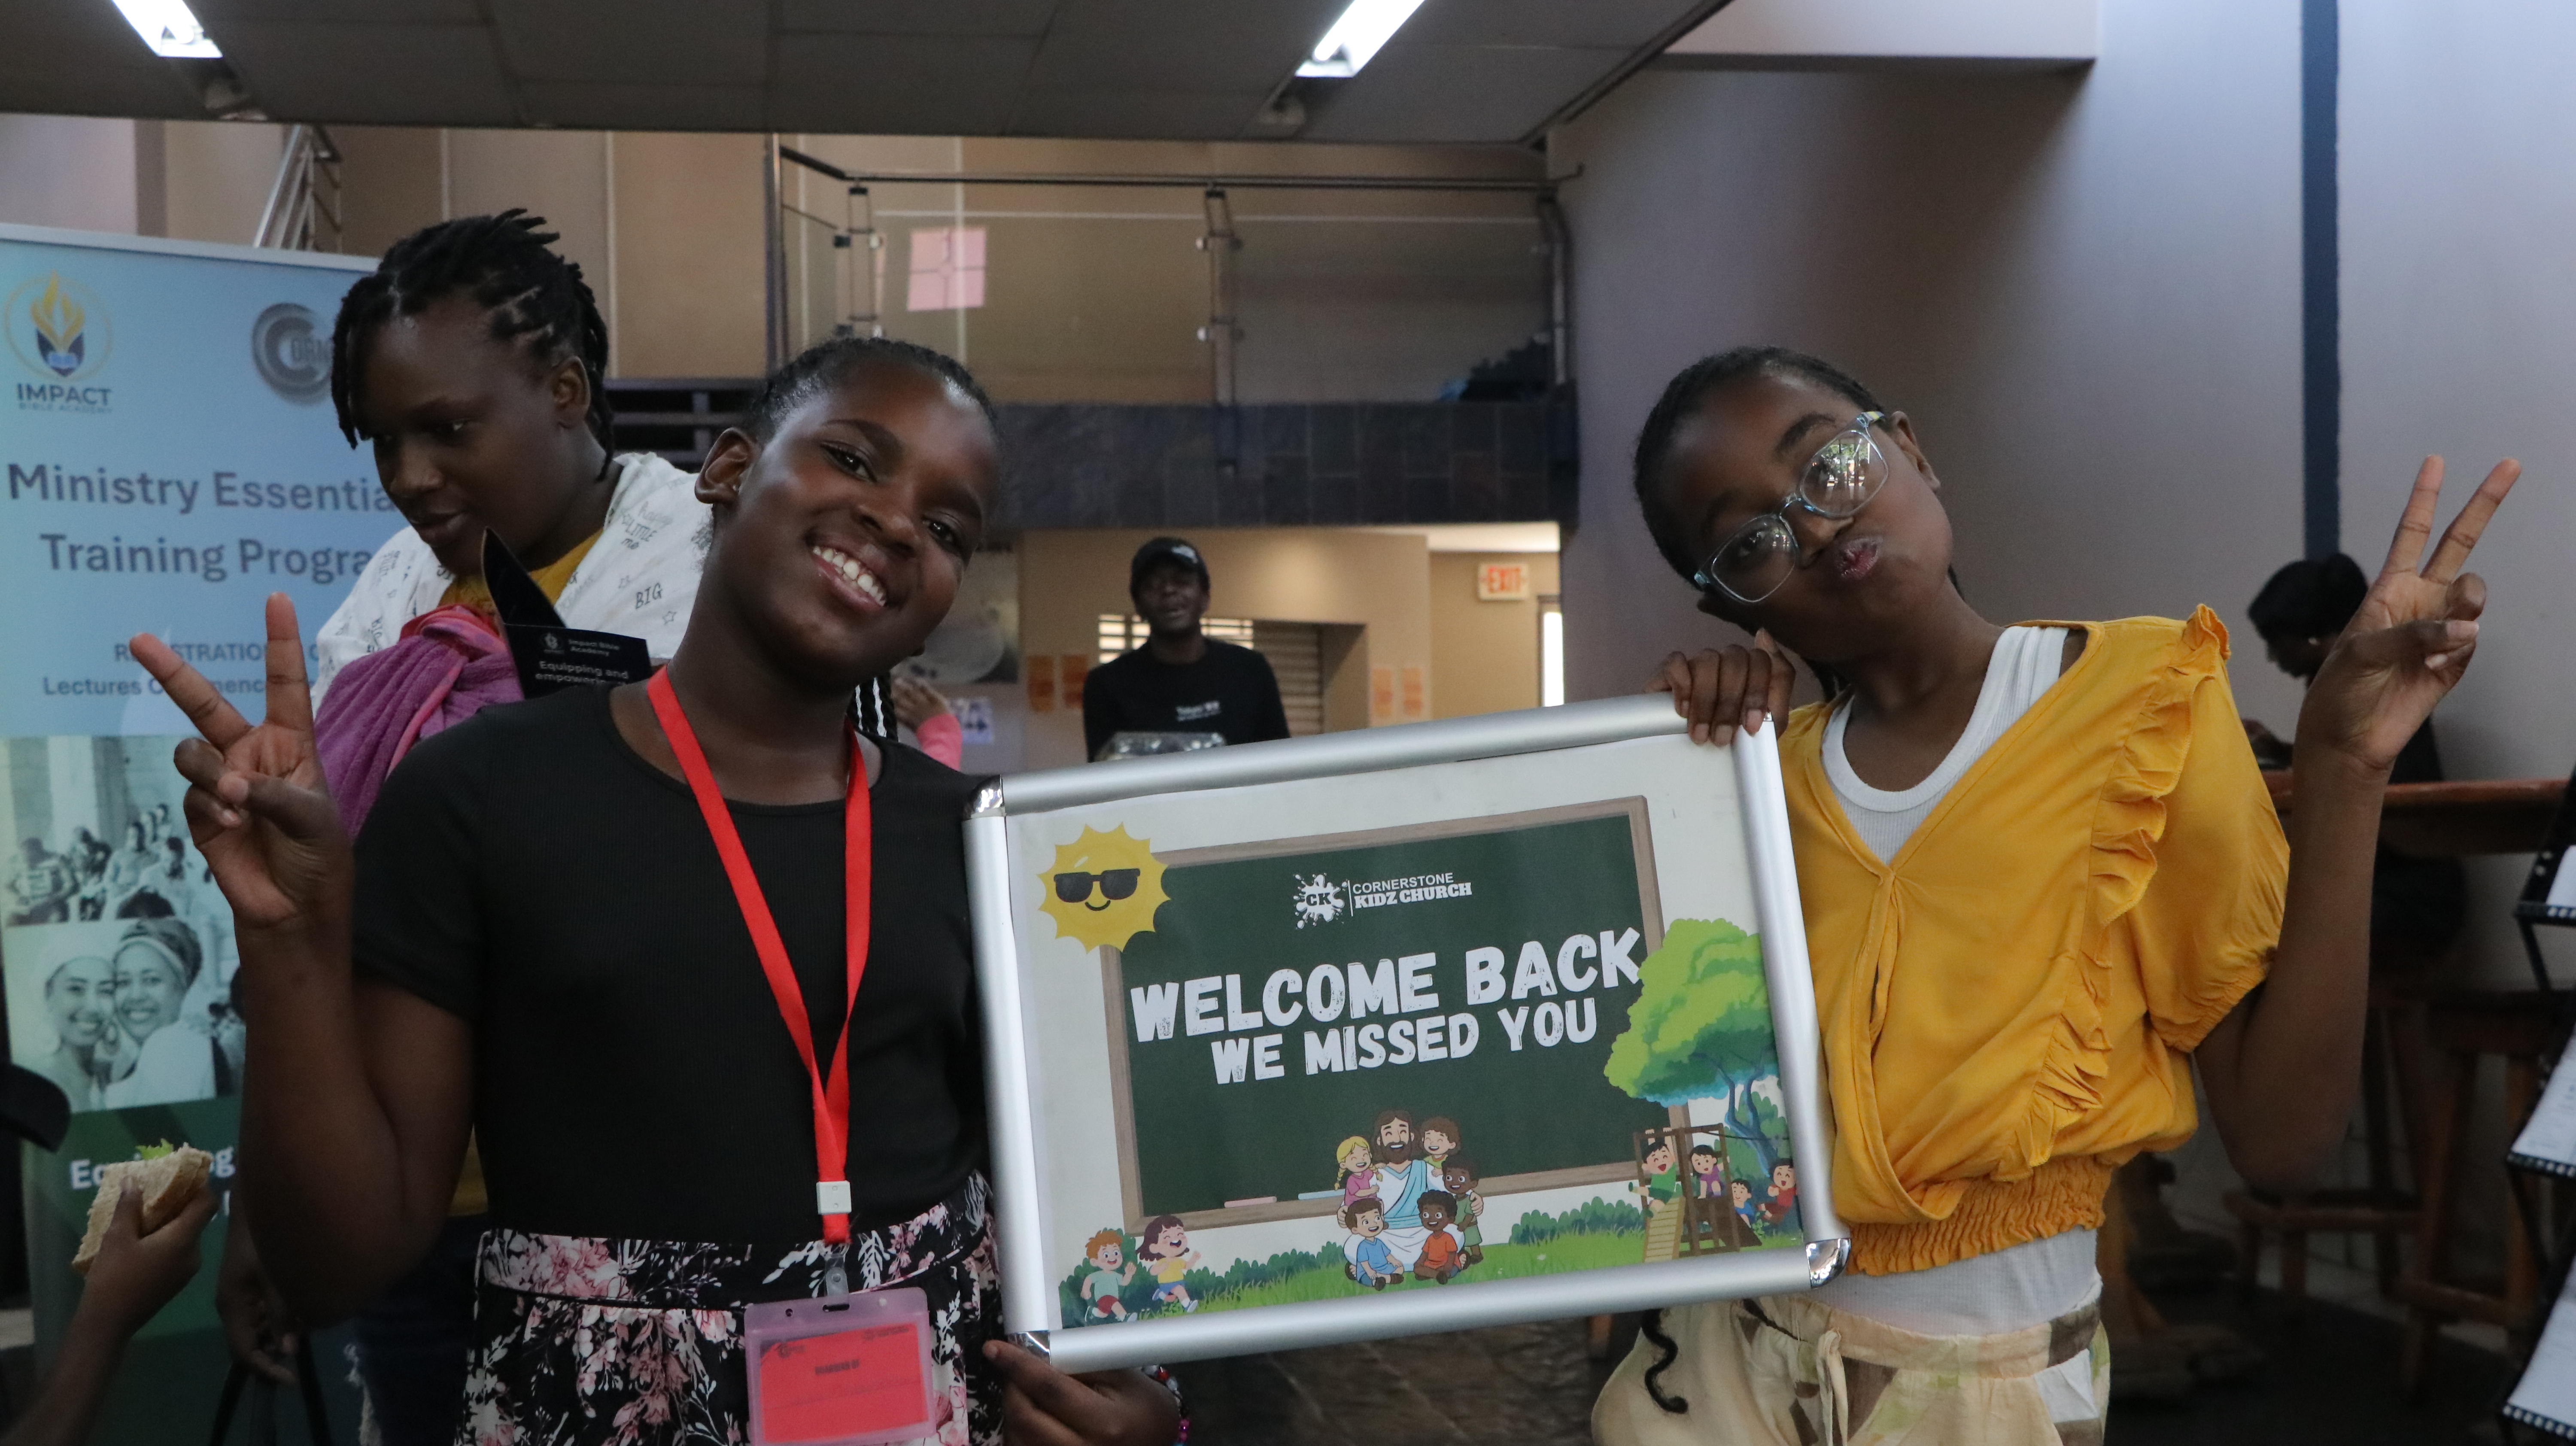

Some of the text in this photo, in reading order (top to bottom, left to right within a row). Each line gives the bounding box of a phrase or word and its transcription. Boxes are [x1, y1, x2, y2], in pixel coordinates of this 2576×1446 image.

[17, 383, 112, 407] IMPACT
[7, 463, 397, 514] Ministry Essentia
[39, 533, 228, 583] Training
[239, 538, 373, 585] Progra
[1487, 566, 1521, 593] EXIT
[635, 582, 663, 609] BIG
[539, 660, 629, 680] Equipping and
[43, 677, 142, 696] Lectures
[1352, 872, 1455, 894] CORNERSTONE
[1354, 882, 1473, 909] KIDZ CHURCH
[1306, 893, 1331, 907] CK
[1130, 927, 1641, 1042] WELCOME BACK
[1210, 997, 1597, 1084] WE MISSED YOU
